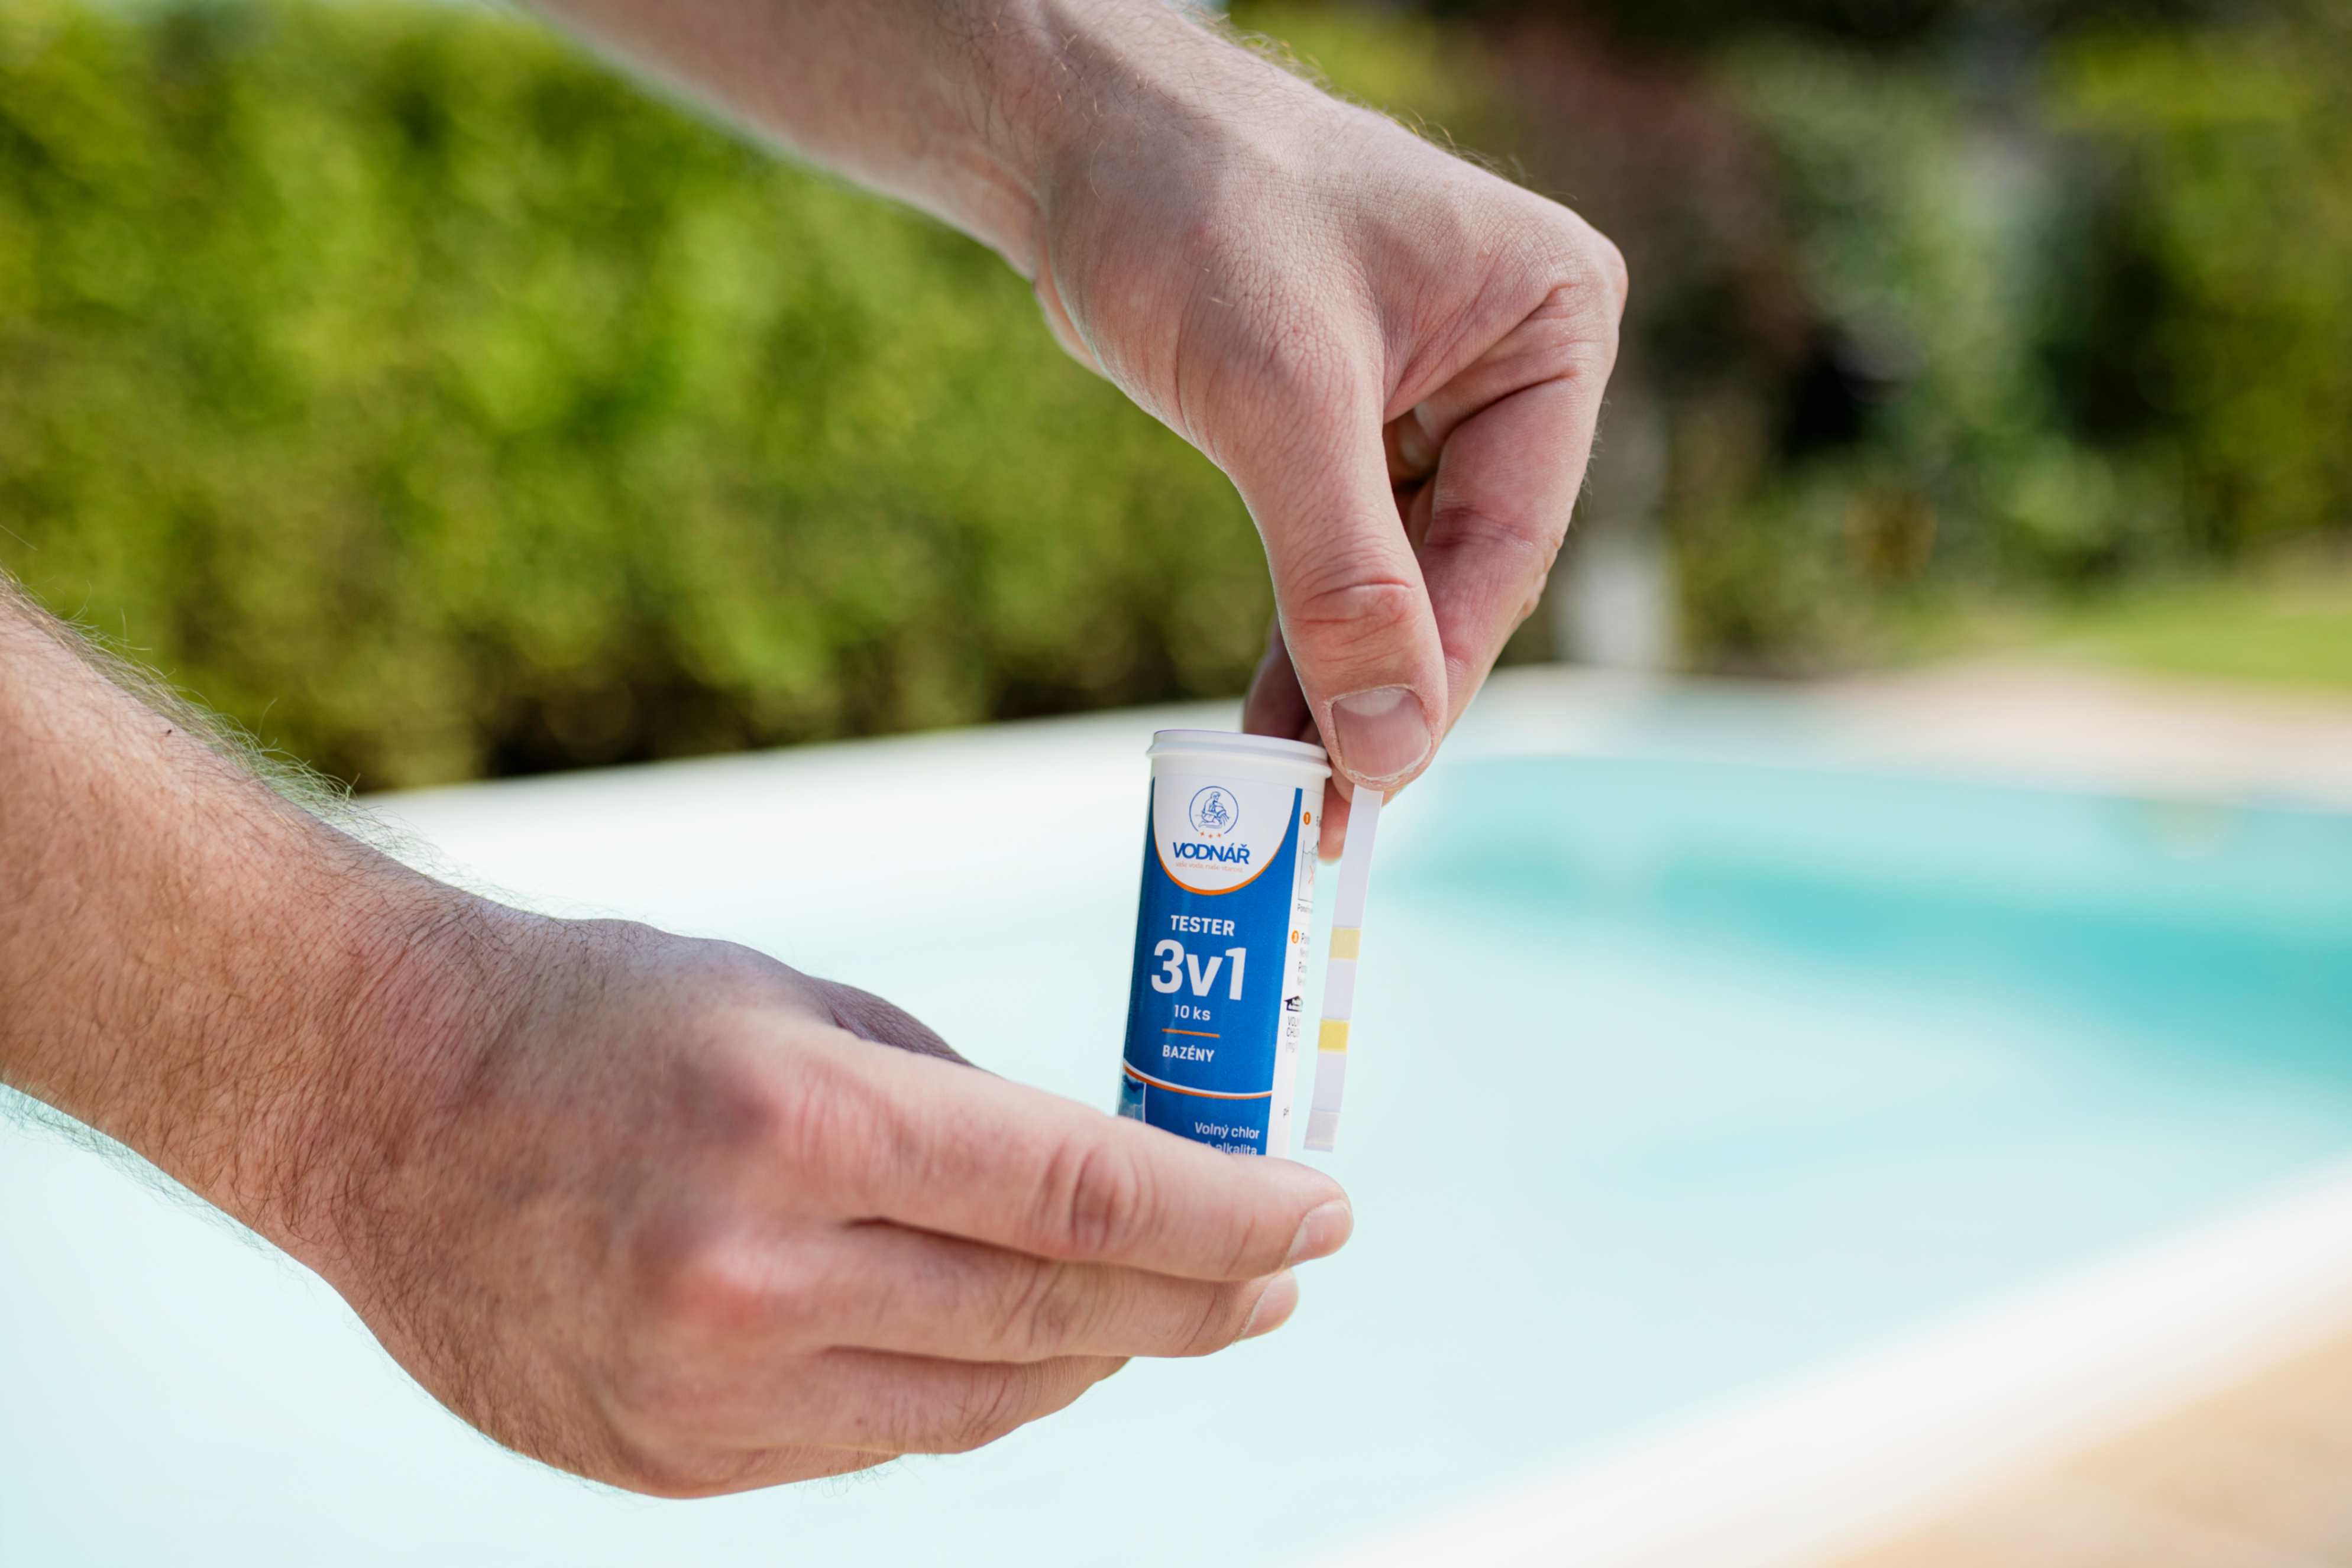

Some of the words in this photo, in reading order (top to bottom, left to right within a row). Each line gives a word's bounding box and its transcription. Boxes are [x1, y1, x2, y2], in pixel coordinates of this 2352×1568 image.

[1173, 842, 1250, 864] VODNÁŘ
[1170, 915, 1235, 937] TESTER
[1151, 939, 1247, 1000] 3v1
[1175, 1005, 1189, 1019] 10
[1193, 1006, 1211, 1021] ks
[1162, 1045, 1215, 1062] BAZÉNY
[1195, 1122, 1229, 1139] Volný
[1231, 1126, 1260, 1139] chlor
